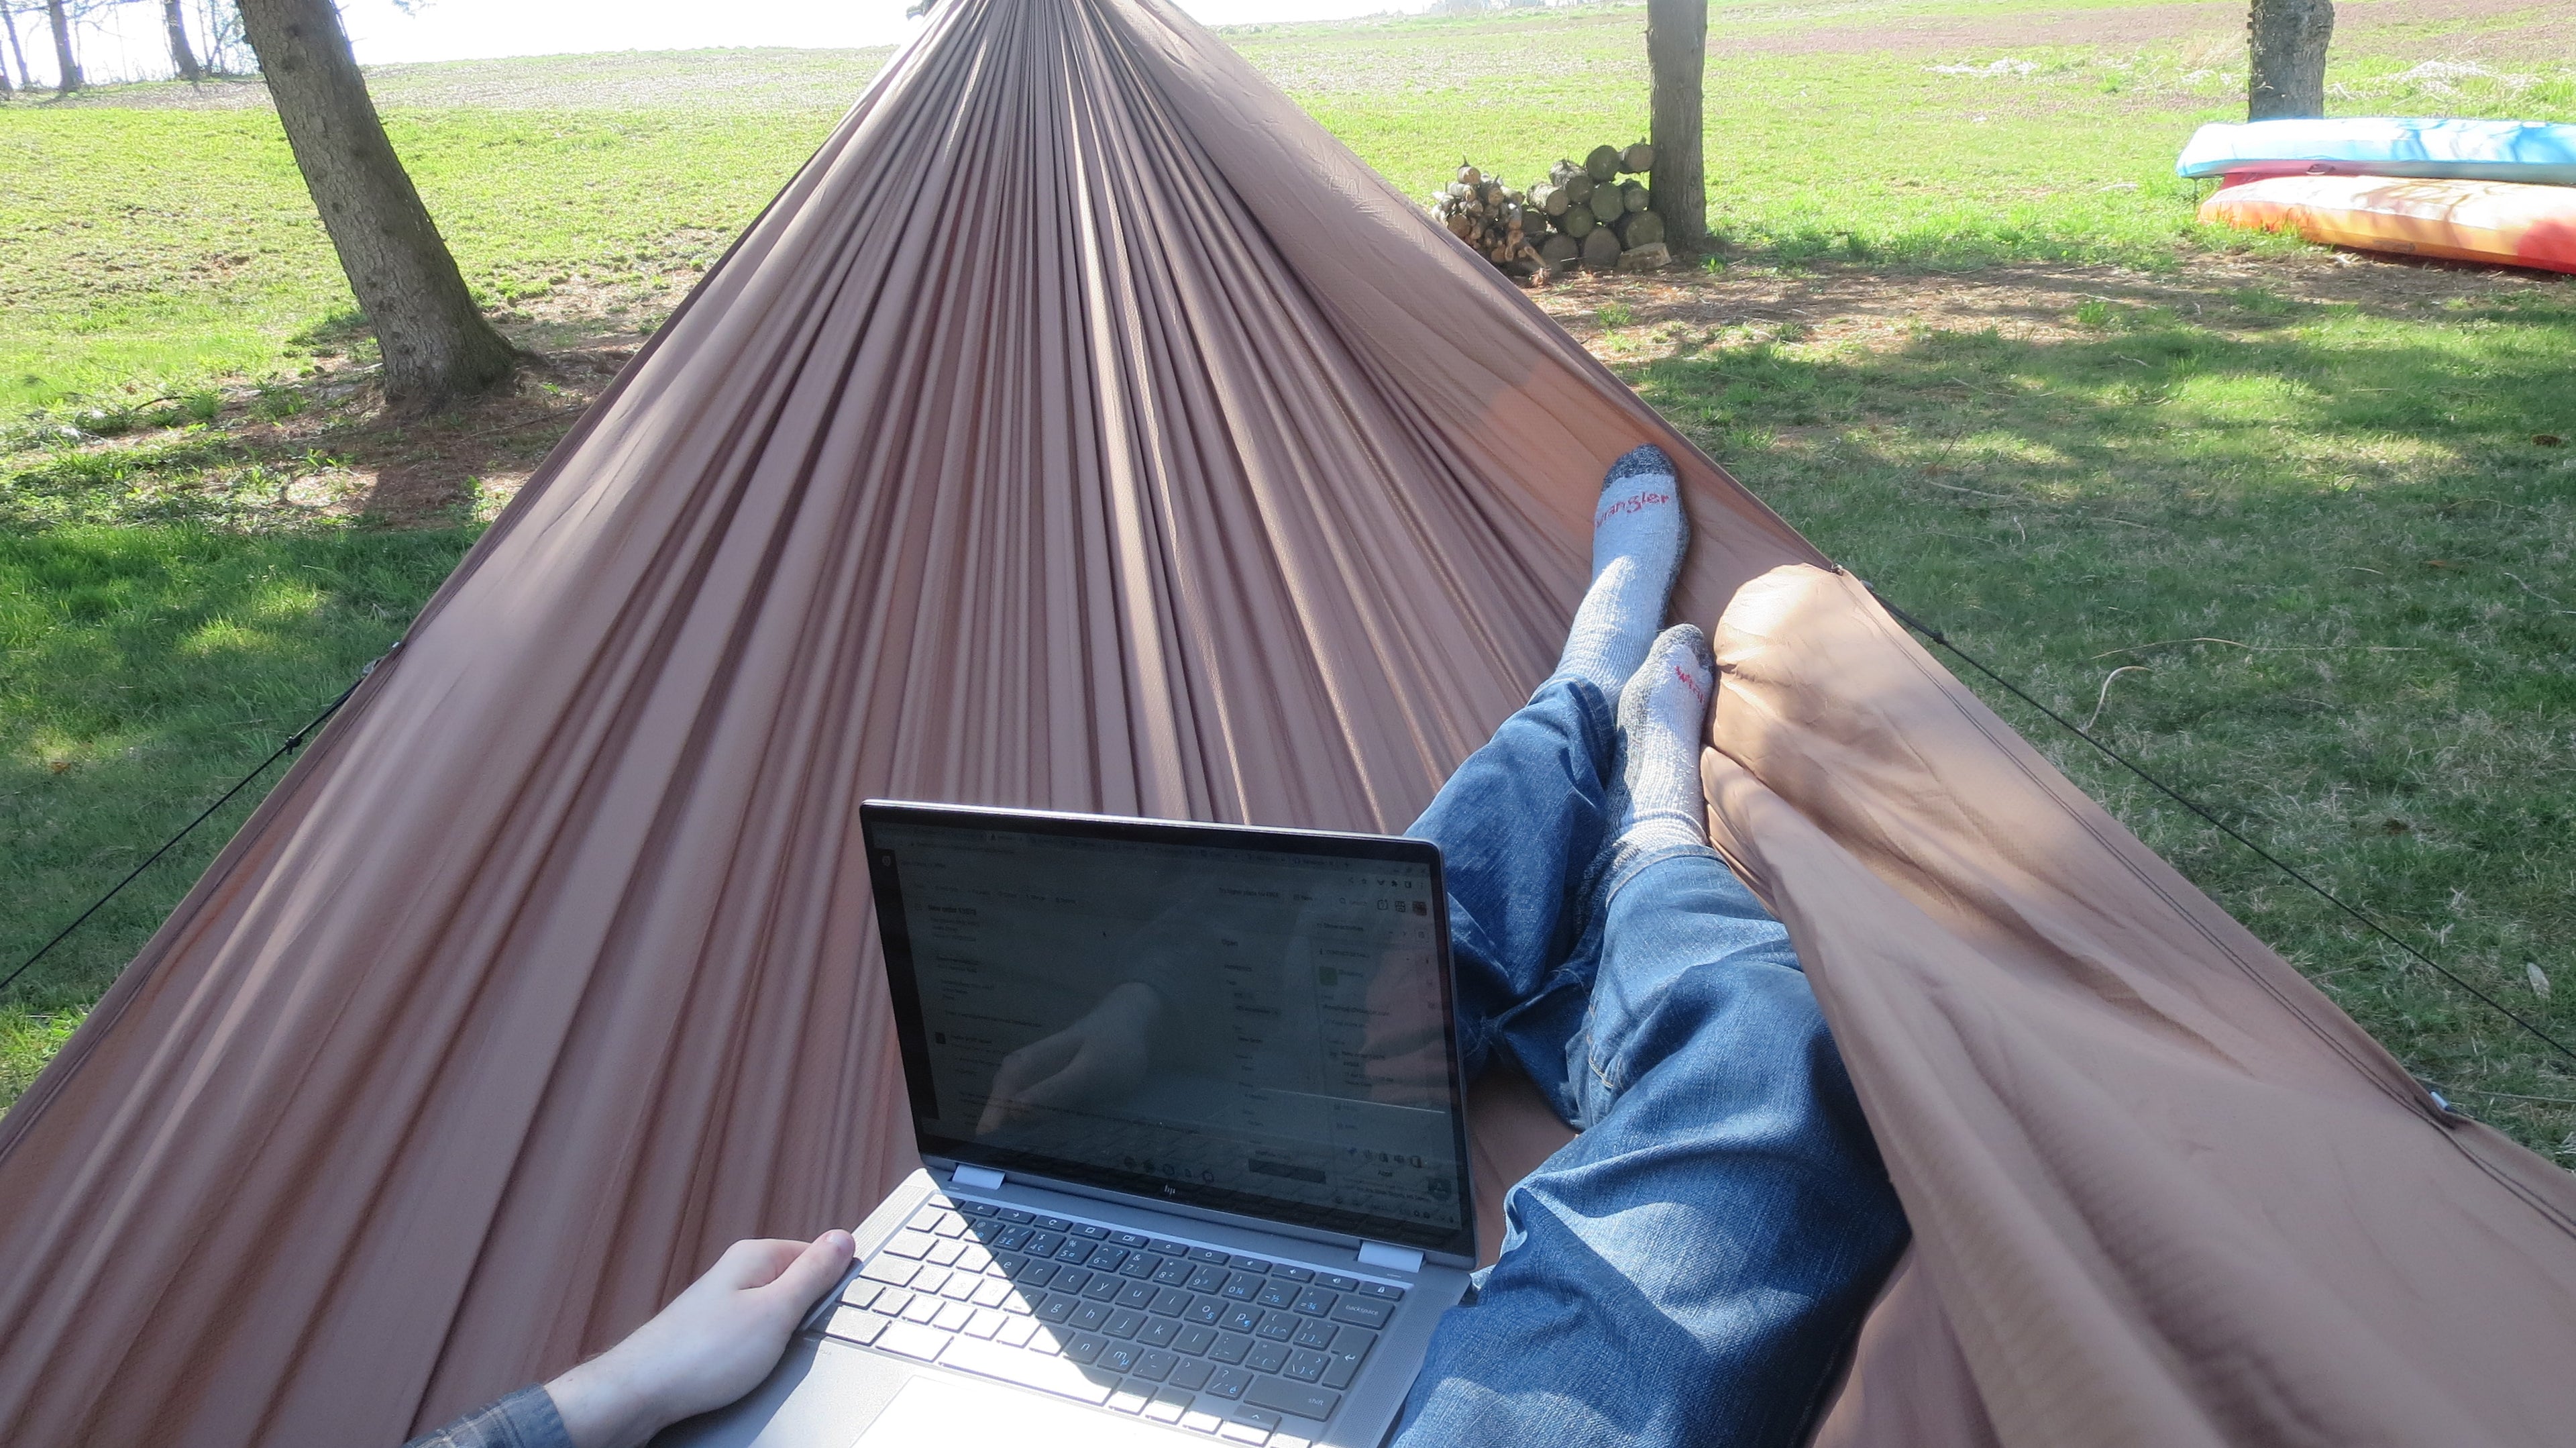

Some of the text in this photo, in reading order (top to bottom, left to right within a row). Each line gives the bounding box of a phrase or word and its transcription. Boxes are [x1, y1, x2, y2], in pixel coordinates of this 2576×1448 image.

[1097, 1282, 1109, 1292] y
[1051, 1304, 1062, 1313] g
[1346, 1304, 1379, 1316] backspace
[1085, 1309, 1095, 1319] h
[1119, 1318, 1130, 1329] j
[1155, 1325, 1164, 1335] k
[1308, 1398, 1324, 1406] shift
